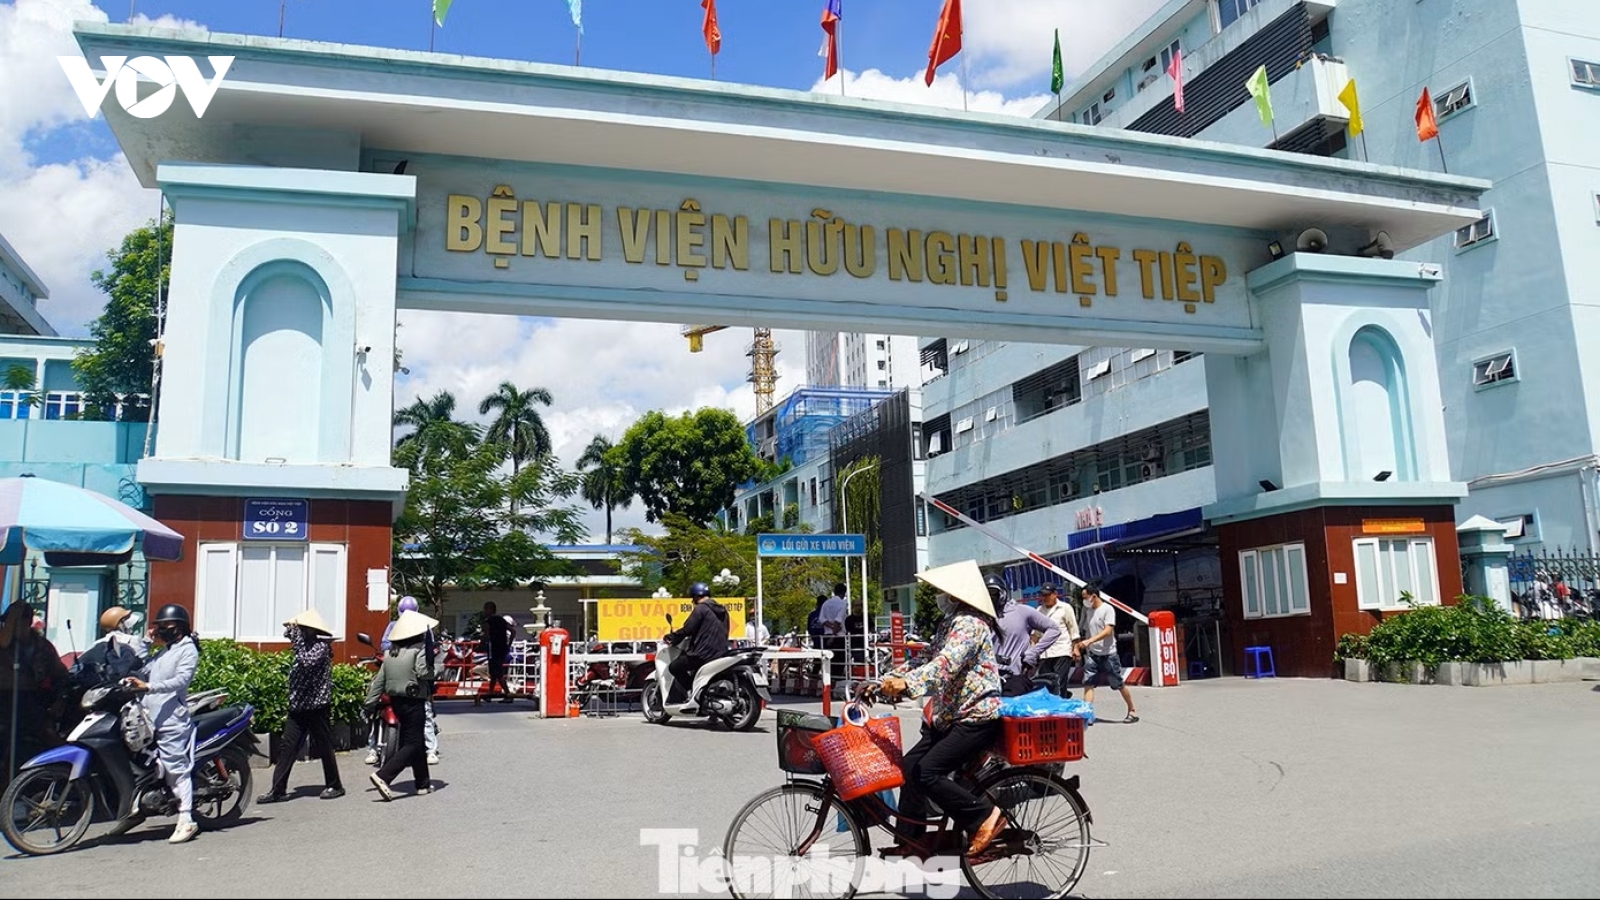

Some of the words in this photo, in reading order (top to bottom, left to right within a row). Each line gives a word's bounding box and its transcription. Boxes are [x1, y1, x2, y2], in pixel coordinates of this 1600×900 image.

[446, 184, 602, 269] BỆNH
[617, 198, 749, 281] VIỆN
[769, 208, 876, 278] HỮU
[886, 227, 1008, 301] NGHỊ
[1020, 232, 1121, 307] VIỆT
[1133, 241, 1227, 313] TIỆP
[252, 516, 280, 534] SỐ
[284, 521, 298, 534] 2
[810, 541, 820, 551] XE
